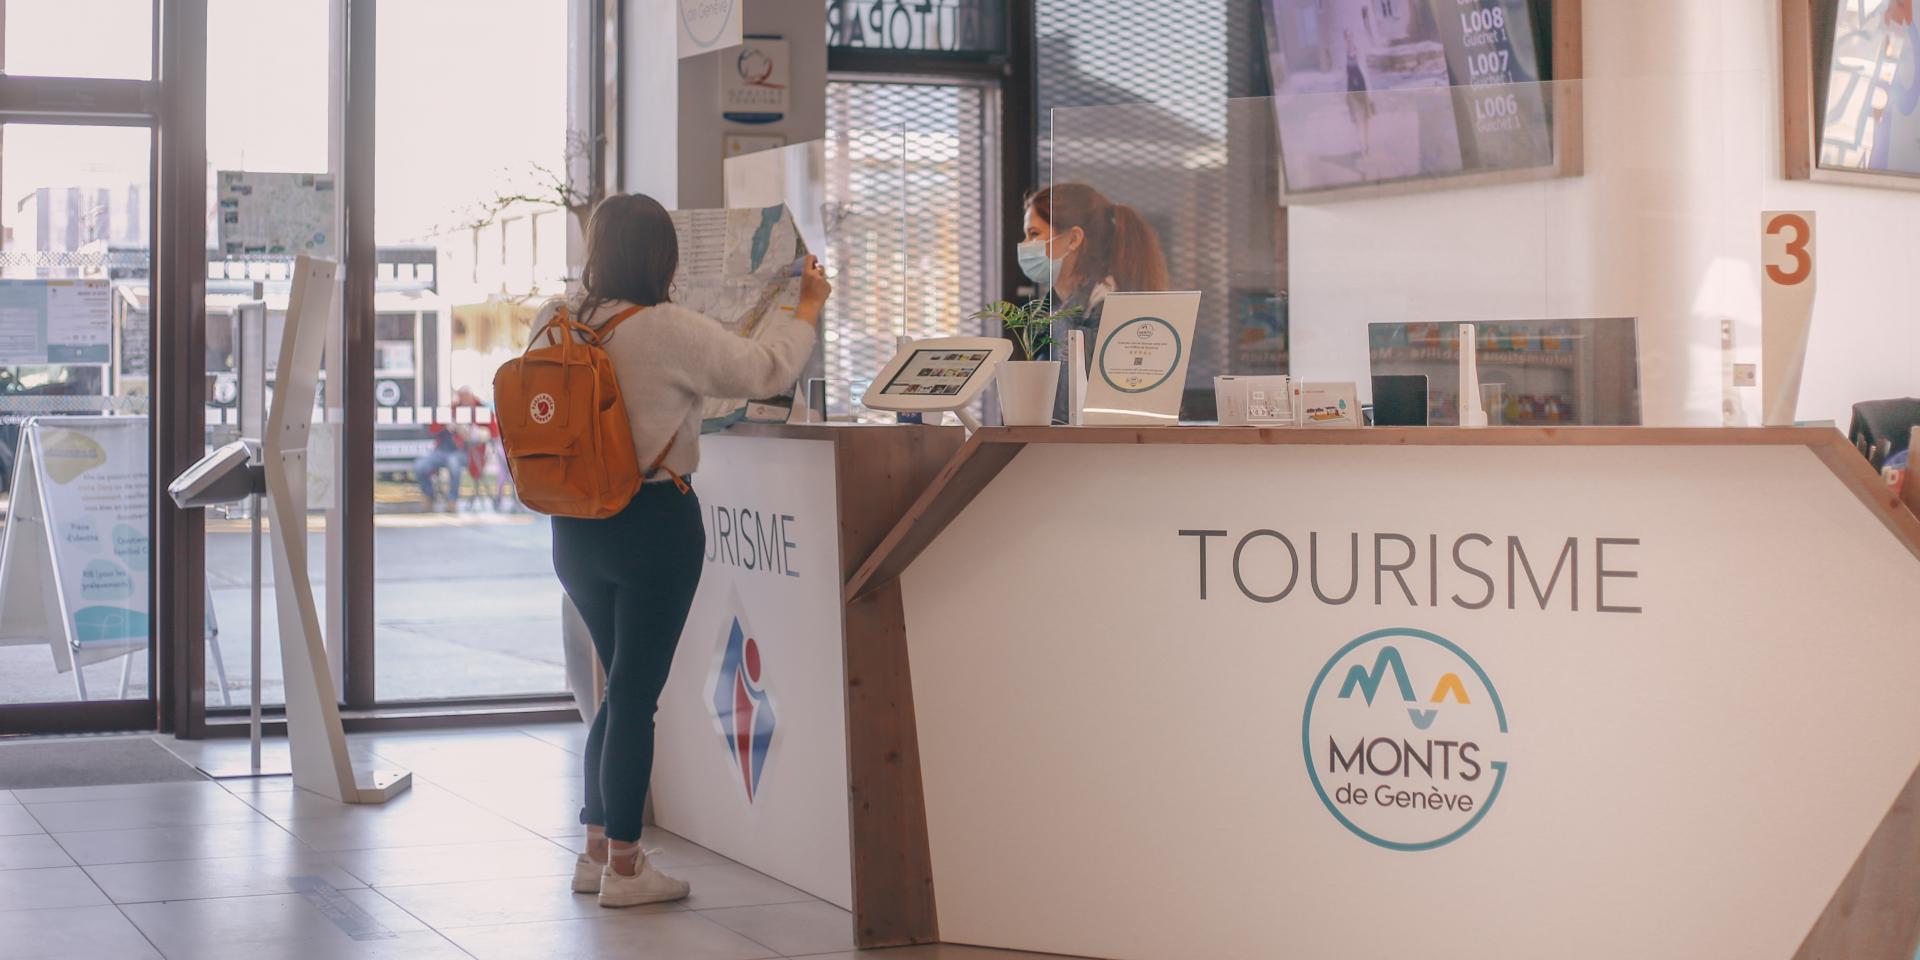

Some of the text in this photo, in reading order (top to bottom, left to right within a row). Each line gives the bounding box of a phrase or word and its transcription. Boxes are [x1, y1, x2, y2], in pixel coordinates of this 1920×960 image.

[1461, 6, 1504, 33] L008
[1463, 31, 1499, 47] Guichet
[1468, 50, 1509, 76] L007
[1475, 94, 1518, 120] L006
[1766, 214, 1811, 285] 3
[705, 505, 800, 577] URISME
[1178, 529, 1642, 613] TOURISME
[1329, 734, 1481, 781] MONTS
[1336, 783, 1473, 812] de Genève
